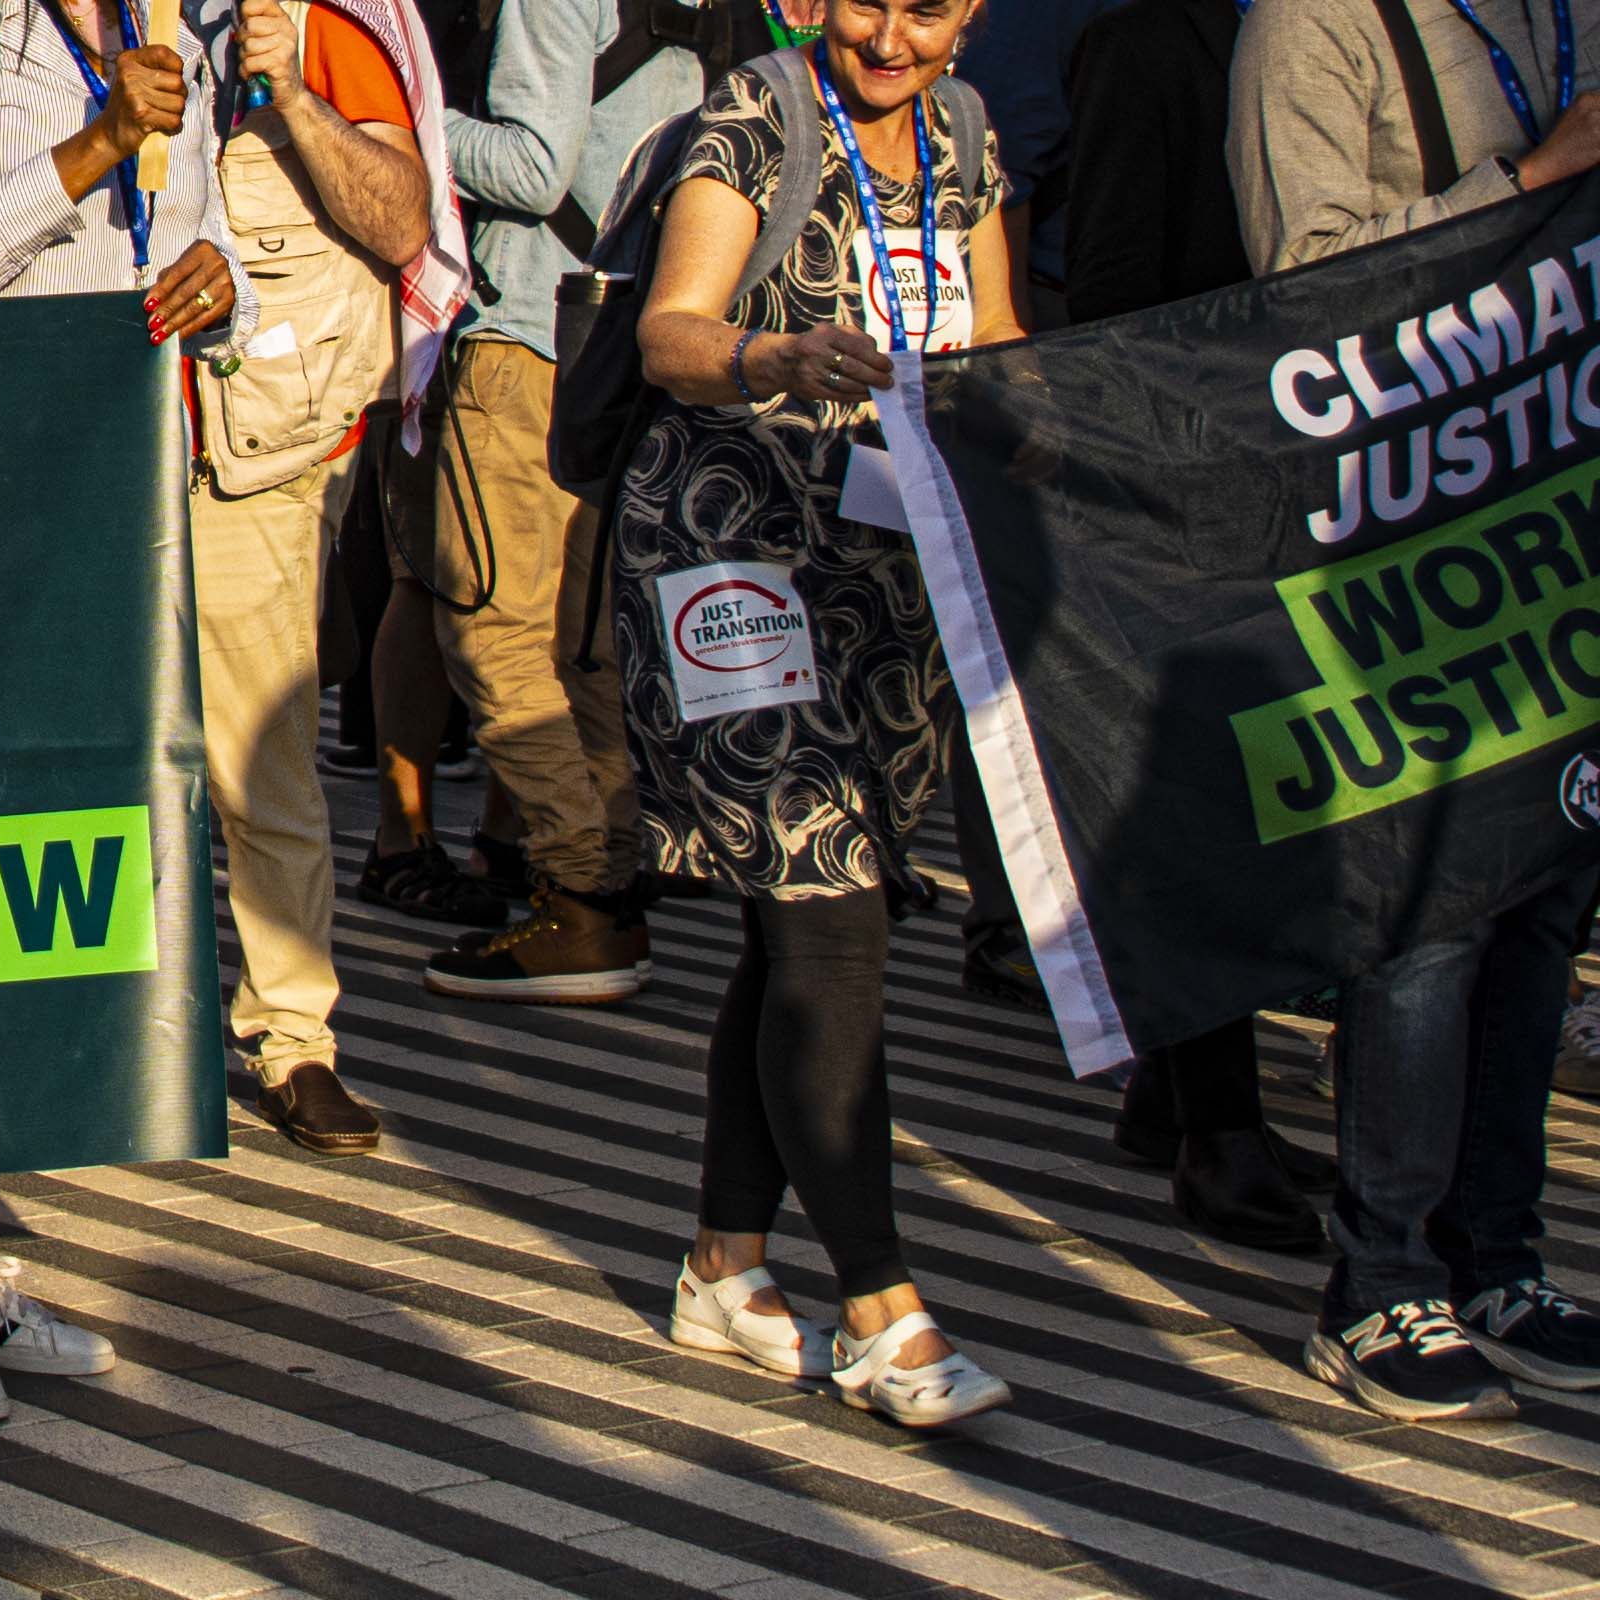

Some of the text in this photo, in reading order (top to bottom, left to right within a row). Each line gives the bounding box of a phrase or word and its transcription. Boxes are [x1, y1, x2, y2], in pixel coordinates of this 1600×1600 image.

[893, 268, 917, 283] UST
[1268, 235, 1600, 438] CLIMAT
[690, 612, 804, 645] TRANSITION
[700, 600, 744, 624] JUST
[1274, 607, 1600, 812] JUSTIC
